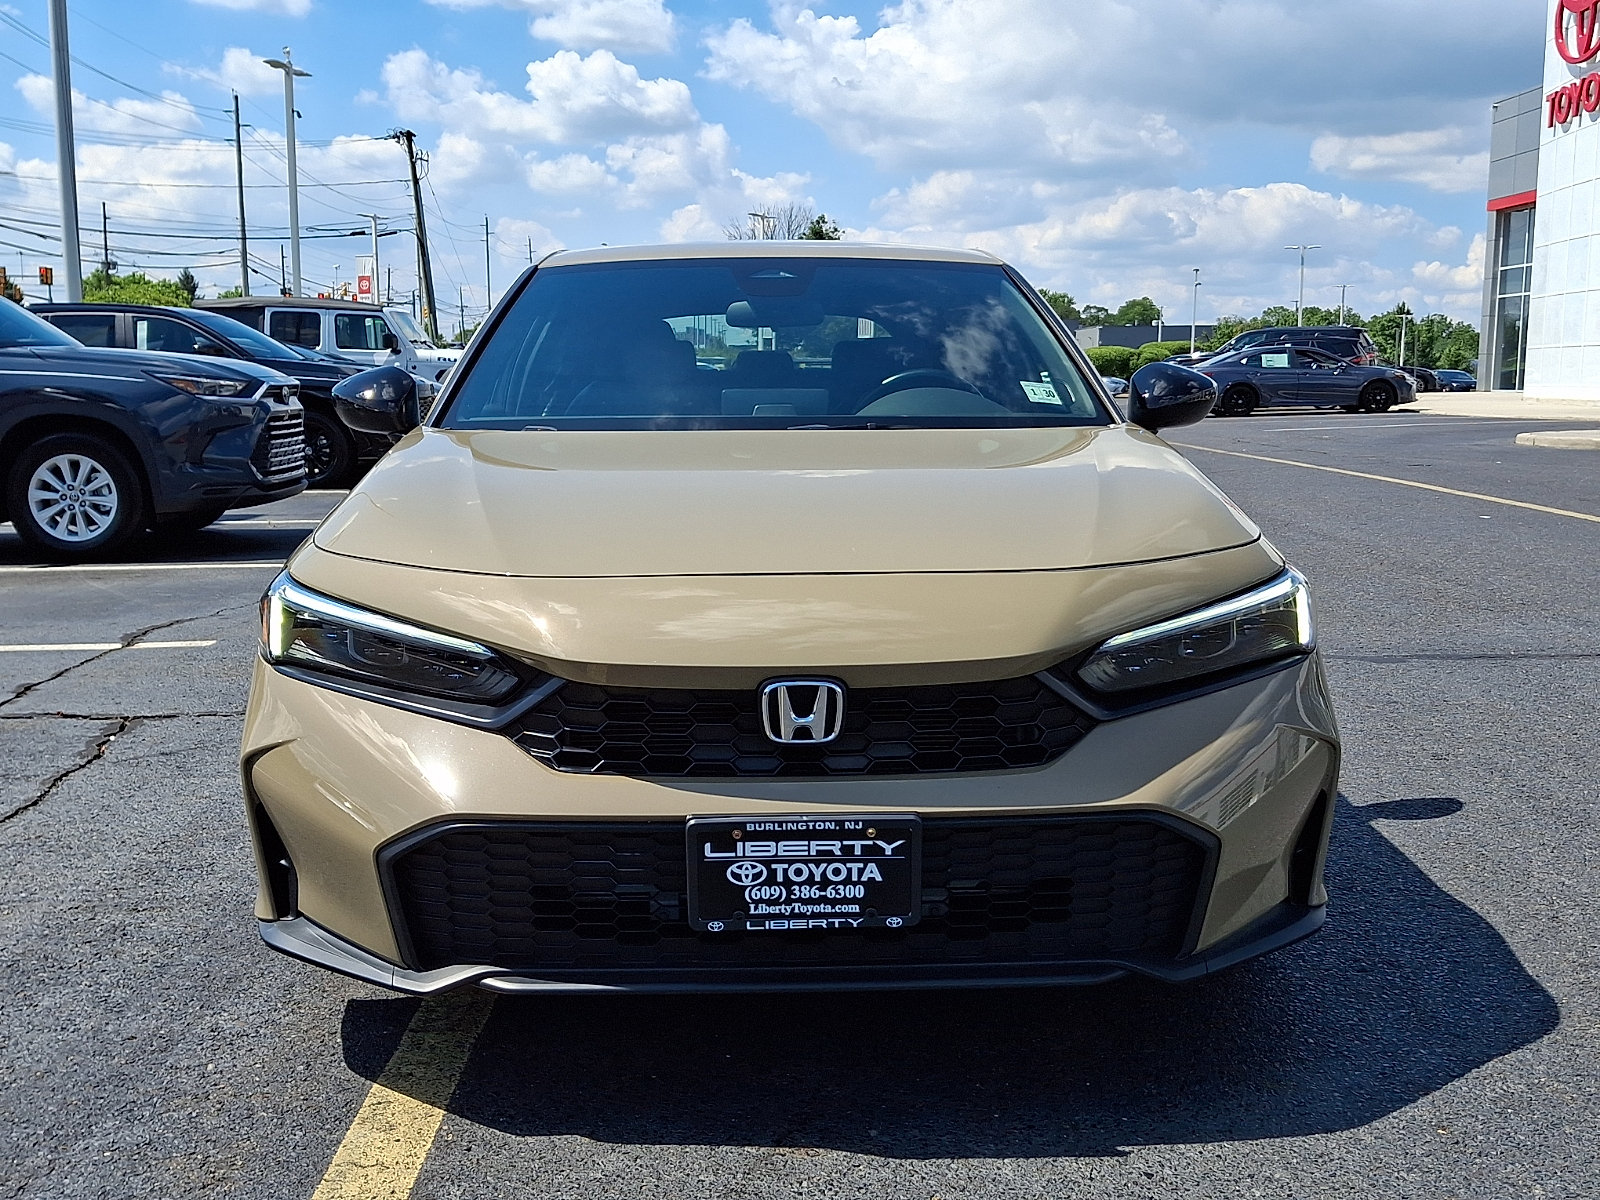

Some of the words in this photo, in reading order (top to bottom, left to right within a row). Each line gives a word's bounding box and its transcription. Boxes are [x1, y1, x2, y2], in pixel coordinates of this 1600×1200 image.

[1042, 389, 1055, 398] 30
[844, 821, 863, 830] NJ
[704, 840, 906, 858] LIBERTY
[771, 862, 883, 882] TOYOTA
[744, 885, 787, 903] (609)
[790, 884, 865, 899] 386-6300
[748, 903, 860, 915] LibertyToyota.com
[746, 918, 864, 930] LIBERTY
